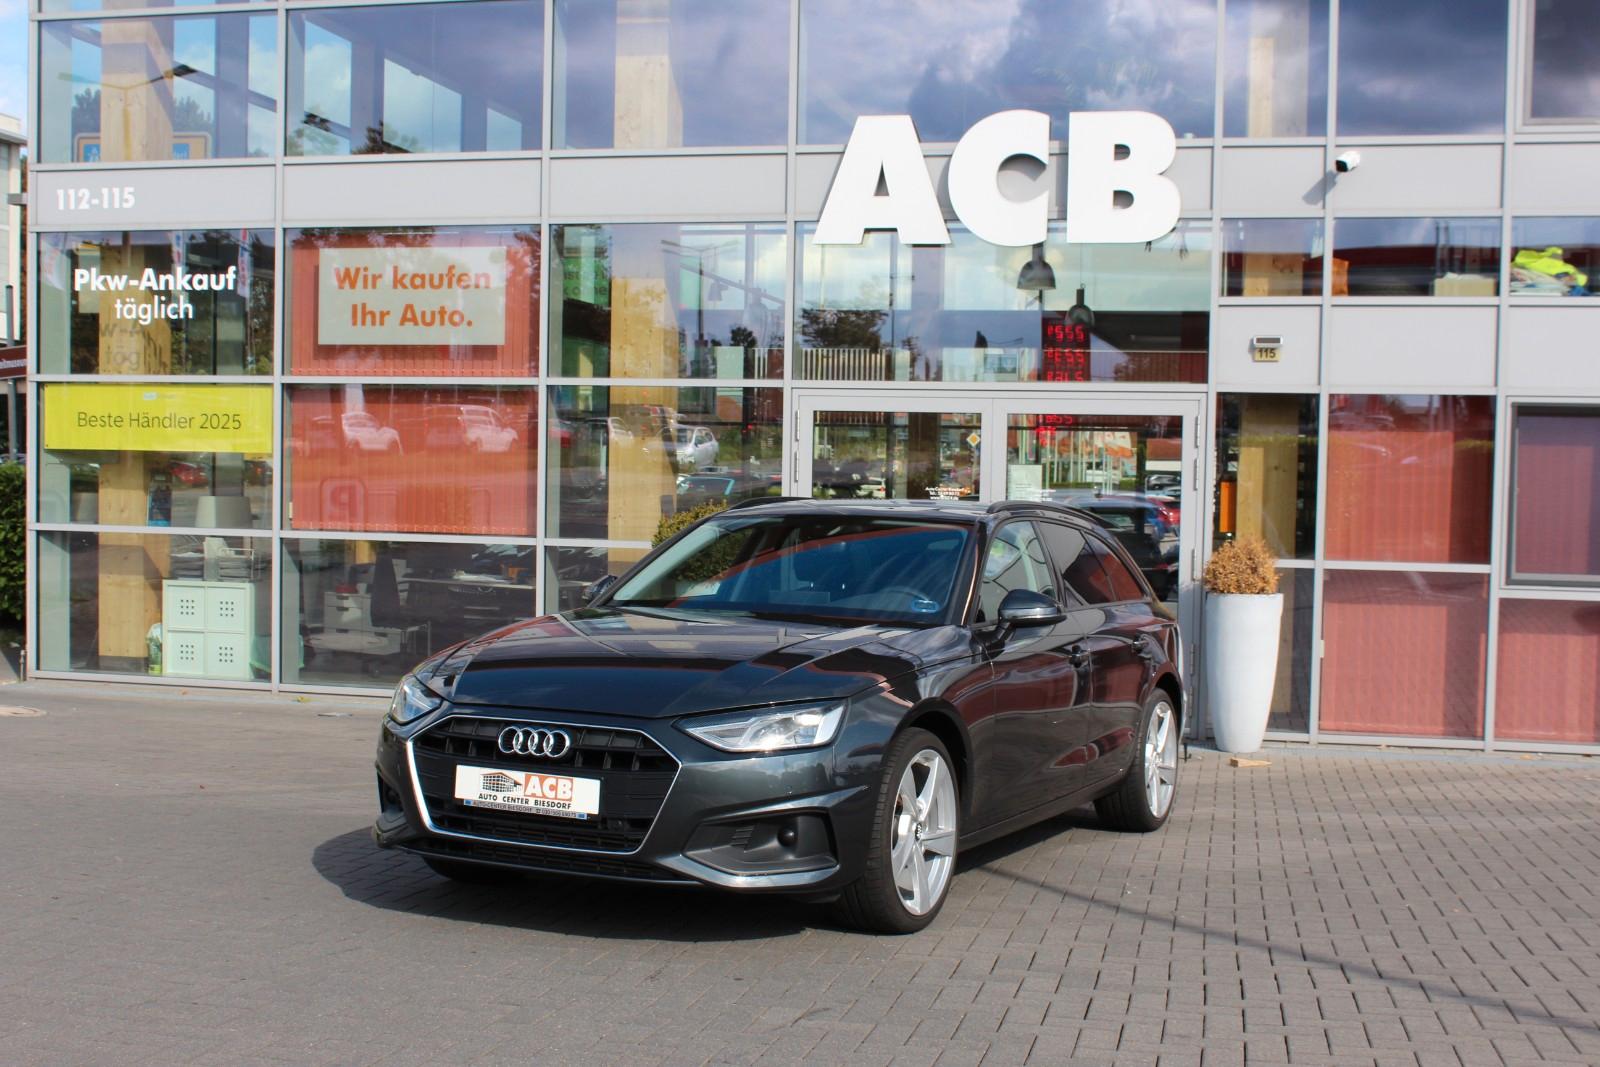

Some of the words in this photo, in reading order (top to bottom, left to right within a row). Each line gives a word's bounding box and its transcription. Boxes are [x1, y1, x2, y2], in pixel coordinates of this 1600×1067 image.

[812, 109, 1181, 247] ACB
[56, 187, 136, 210] 112-115
[73, 265, 237, 292] Pkw-Ankauf
[334, 265, 383, 290] Wir
[392, 264, 492, 290] kaufen
[115, 294, 194, 325] täglich
[351, 302, 391, 327] Ihr
[399, 303, 473, 327] Auto.
[1258, 348, 1276, 358] 115
[77, 411, 124, 428] Beste
[129, 411, 195, 429] Händler
[199, 413, 242, 430] 2025
[525, 775, 573, 801] ACB
[478, 793, 498, 801] AUTO
[502, 796, 530, 805] CENTER
[534, 799, 572, 810] BIESDORF
